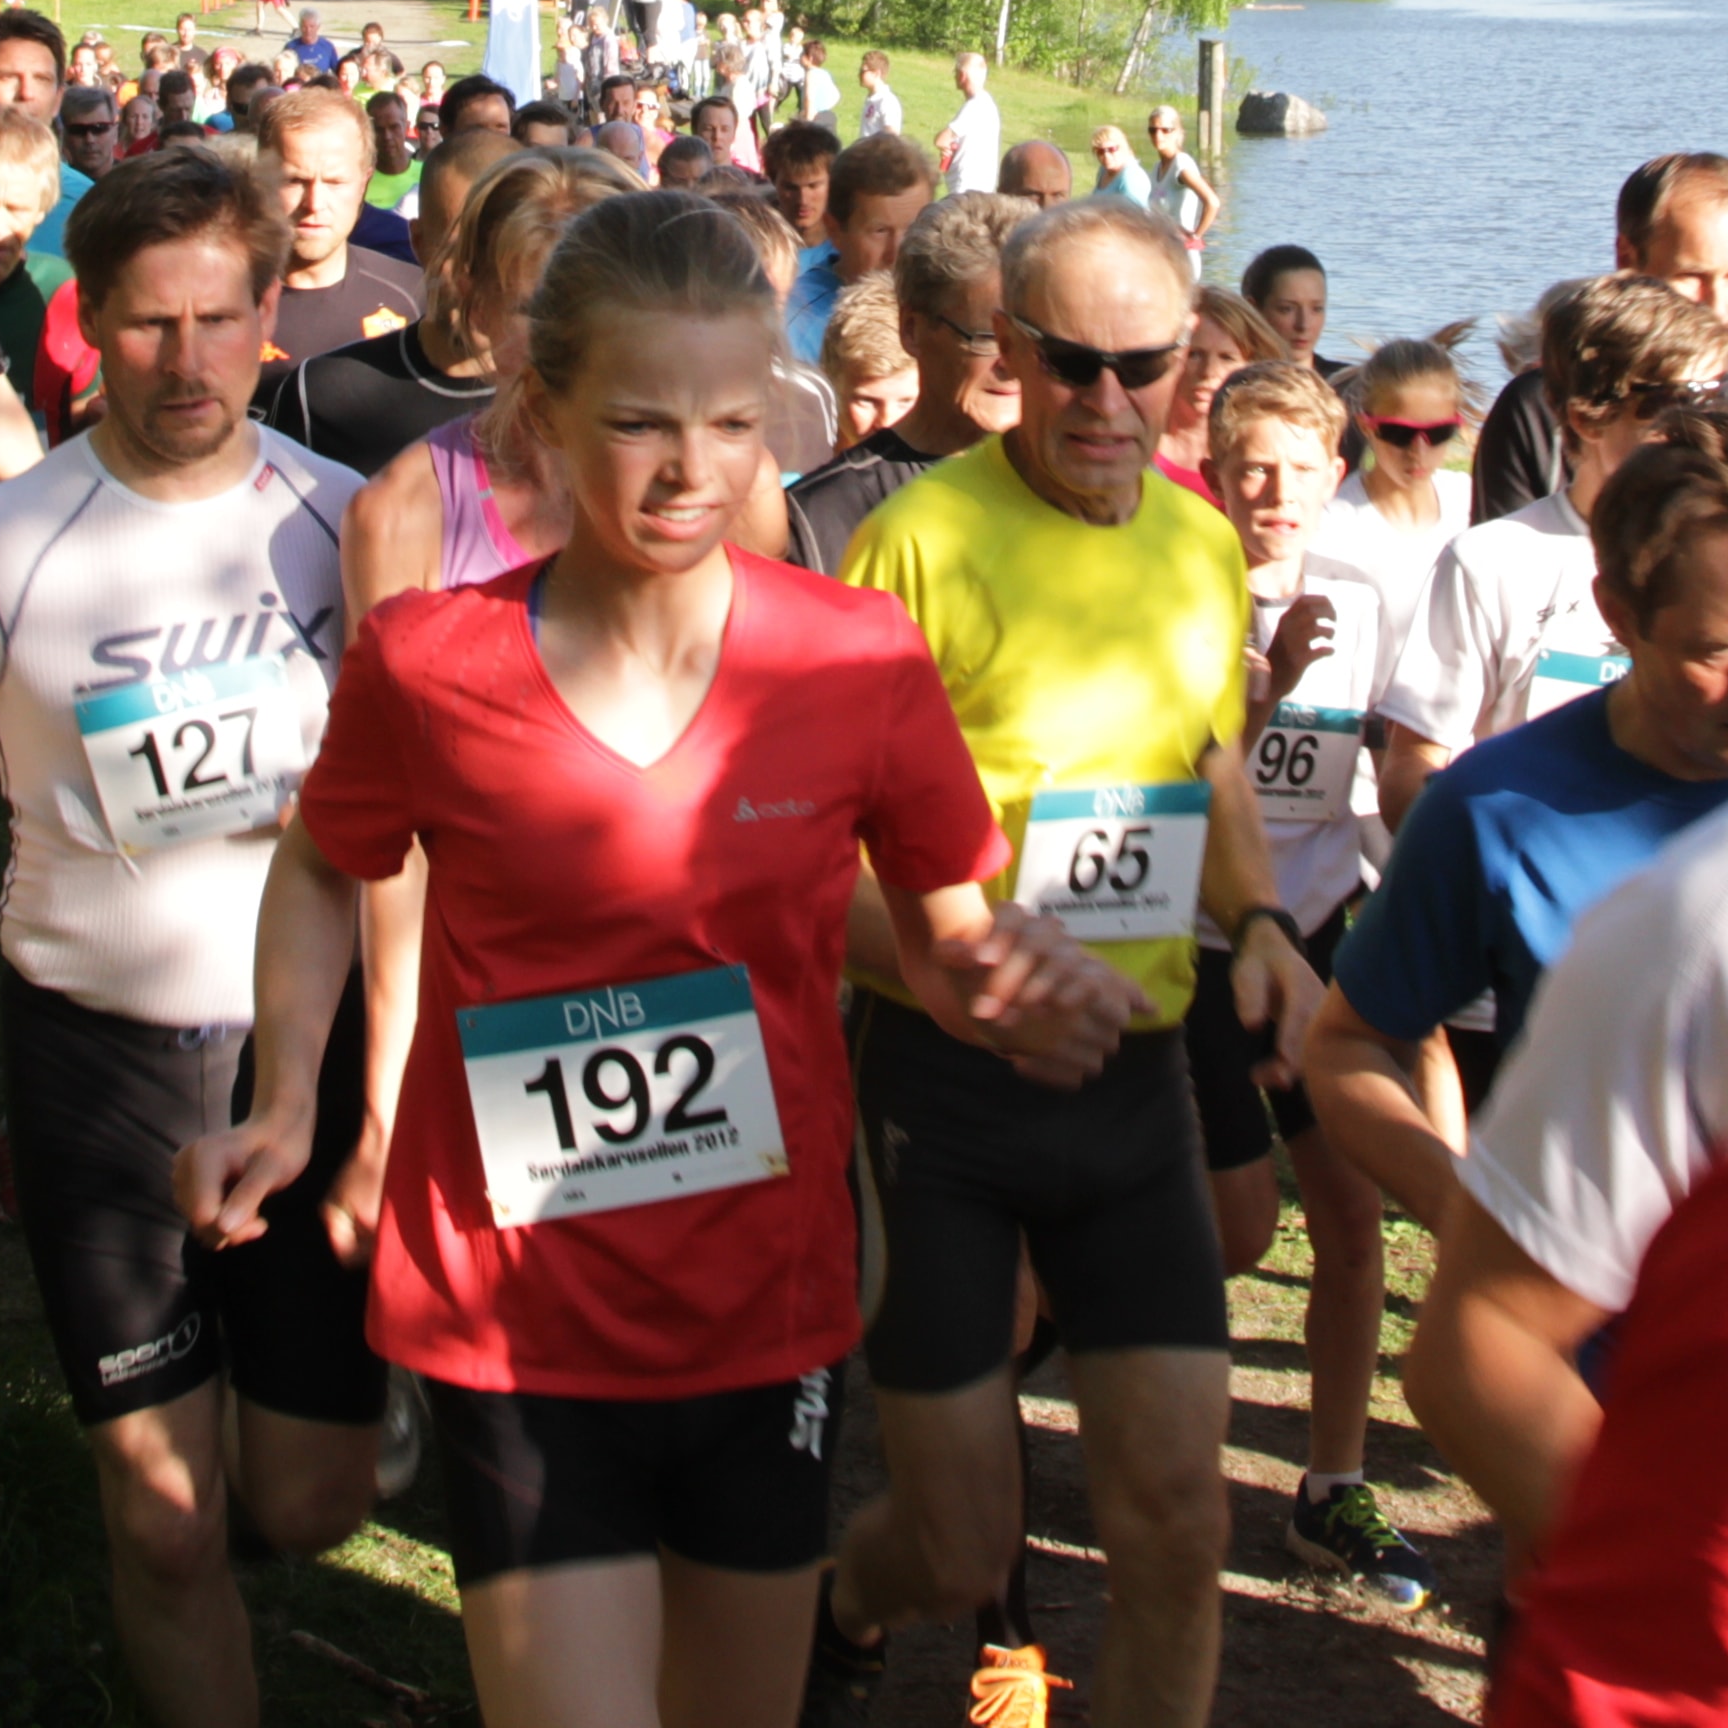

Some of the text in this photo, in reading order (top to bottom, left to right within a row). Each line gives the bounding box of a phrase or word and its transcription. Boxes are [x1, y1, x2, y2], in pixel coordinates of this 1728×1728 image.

[151, 667, 216, 715] DNB
[1599, 660, 1629, 682] DN
[129, 706, 258, 797] 127
[1255, 731, 1319, 786] 96
[1069, 825, 1152, 892] 65
[563, 985, 646, 1040] DNB
[523, 1033, 729, 1152] 192
[692, 1127, 739, 1153] 2012
